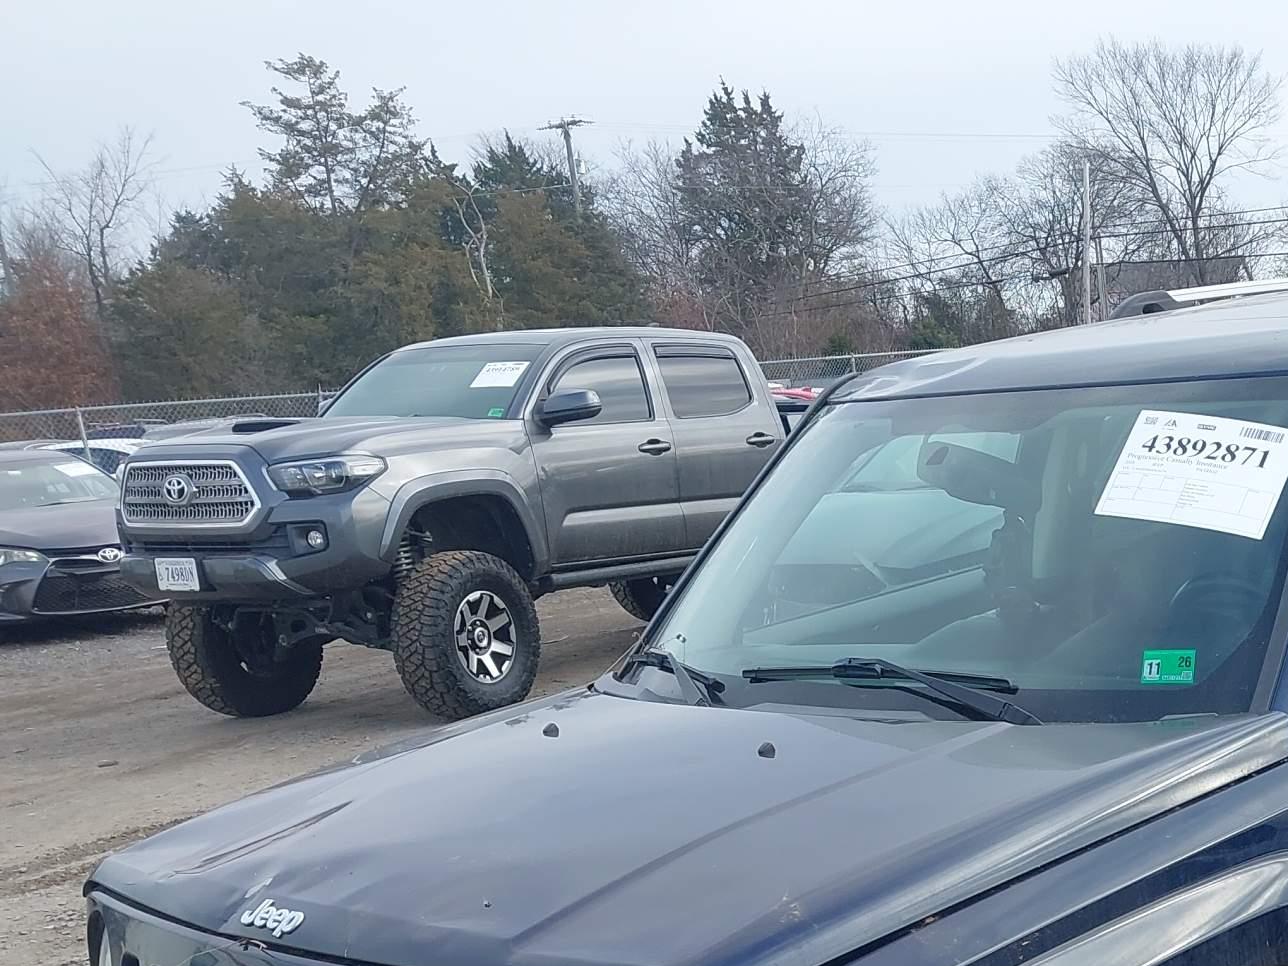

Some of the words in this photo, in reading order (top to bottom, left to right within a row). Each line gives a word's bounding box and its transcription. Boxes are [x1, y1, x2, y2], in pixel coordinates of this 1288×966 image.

[1142, 434, 1269, 468] 43892871
[1147, 661, 1160, 676] 11
[1178, 656, 1191, 668] 26
[241, 899, 305, 938] Jeep
